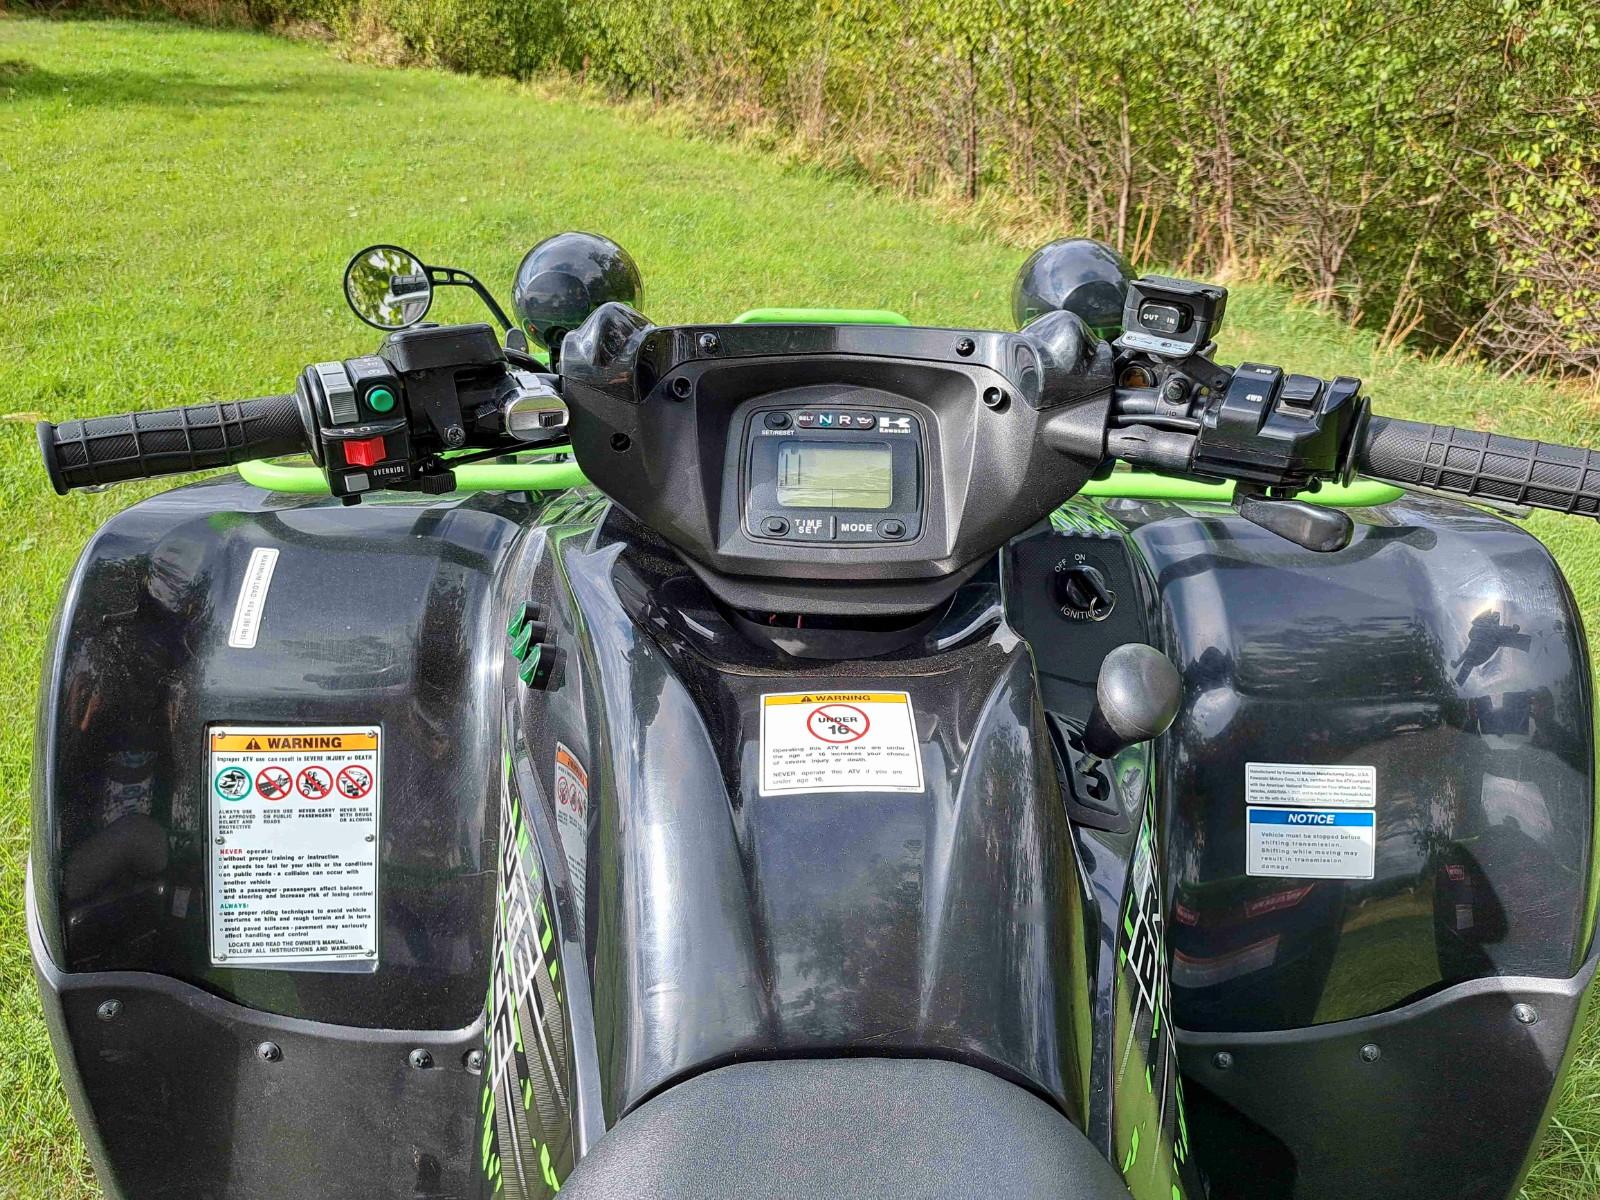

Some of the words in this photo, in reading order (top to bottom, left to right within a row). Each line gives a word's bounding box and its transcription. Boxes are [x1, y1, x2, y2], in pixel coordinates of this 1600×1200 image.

[1143, 313, 1159, 321] OUT
[1166, 316, 1175, 324] IN
[1245, 394, 1263, 402] 4WD
[819, 415, 833, 424] N
[839, 415, 851, 424] R
[373, 465, 405, 476] OVERRIDE
[795, 519, 823, 527] TIME
[798, 526, 818, 534] SET
[841, 524, 873, 532] MODE
[1054, 558, 1067, 573] OFF
[828, 724, 850, 735] 16
[267, 737, 342, 749] WARNING
[1288, 814, 1335, 824] NOTICE
[247, 887, 278, 895] passenger
